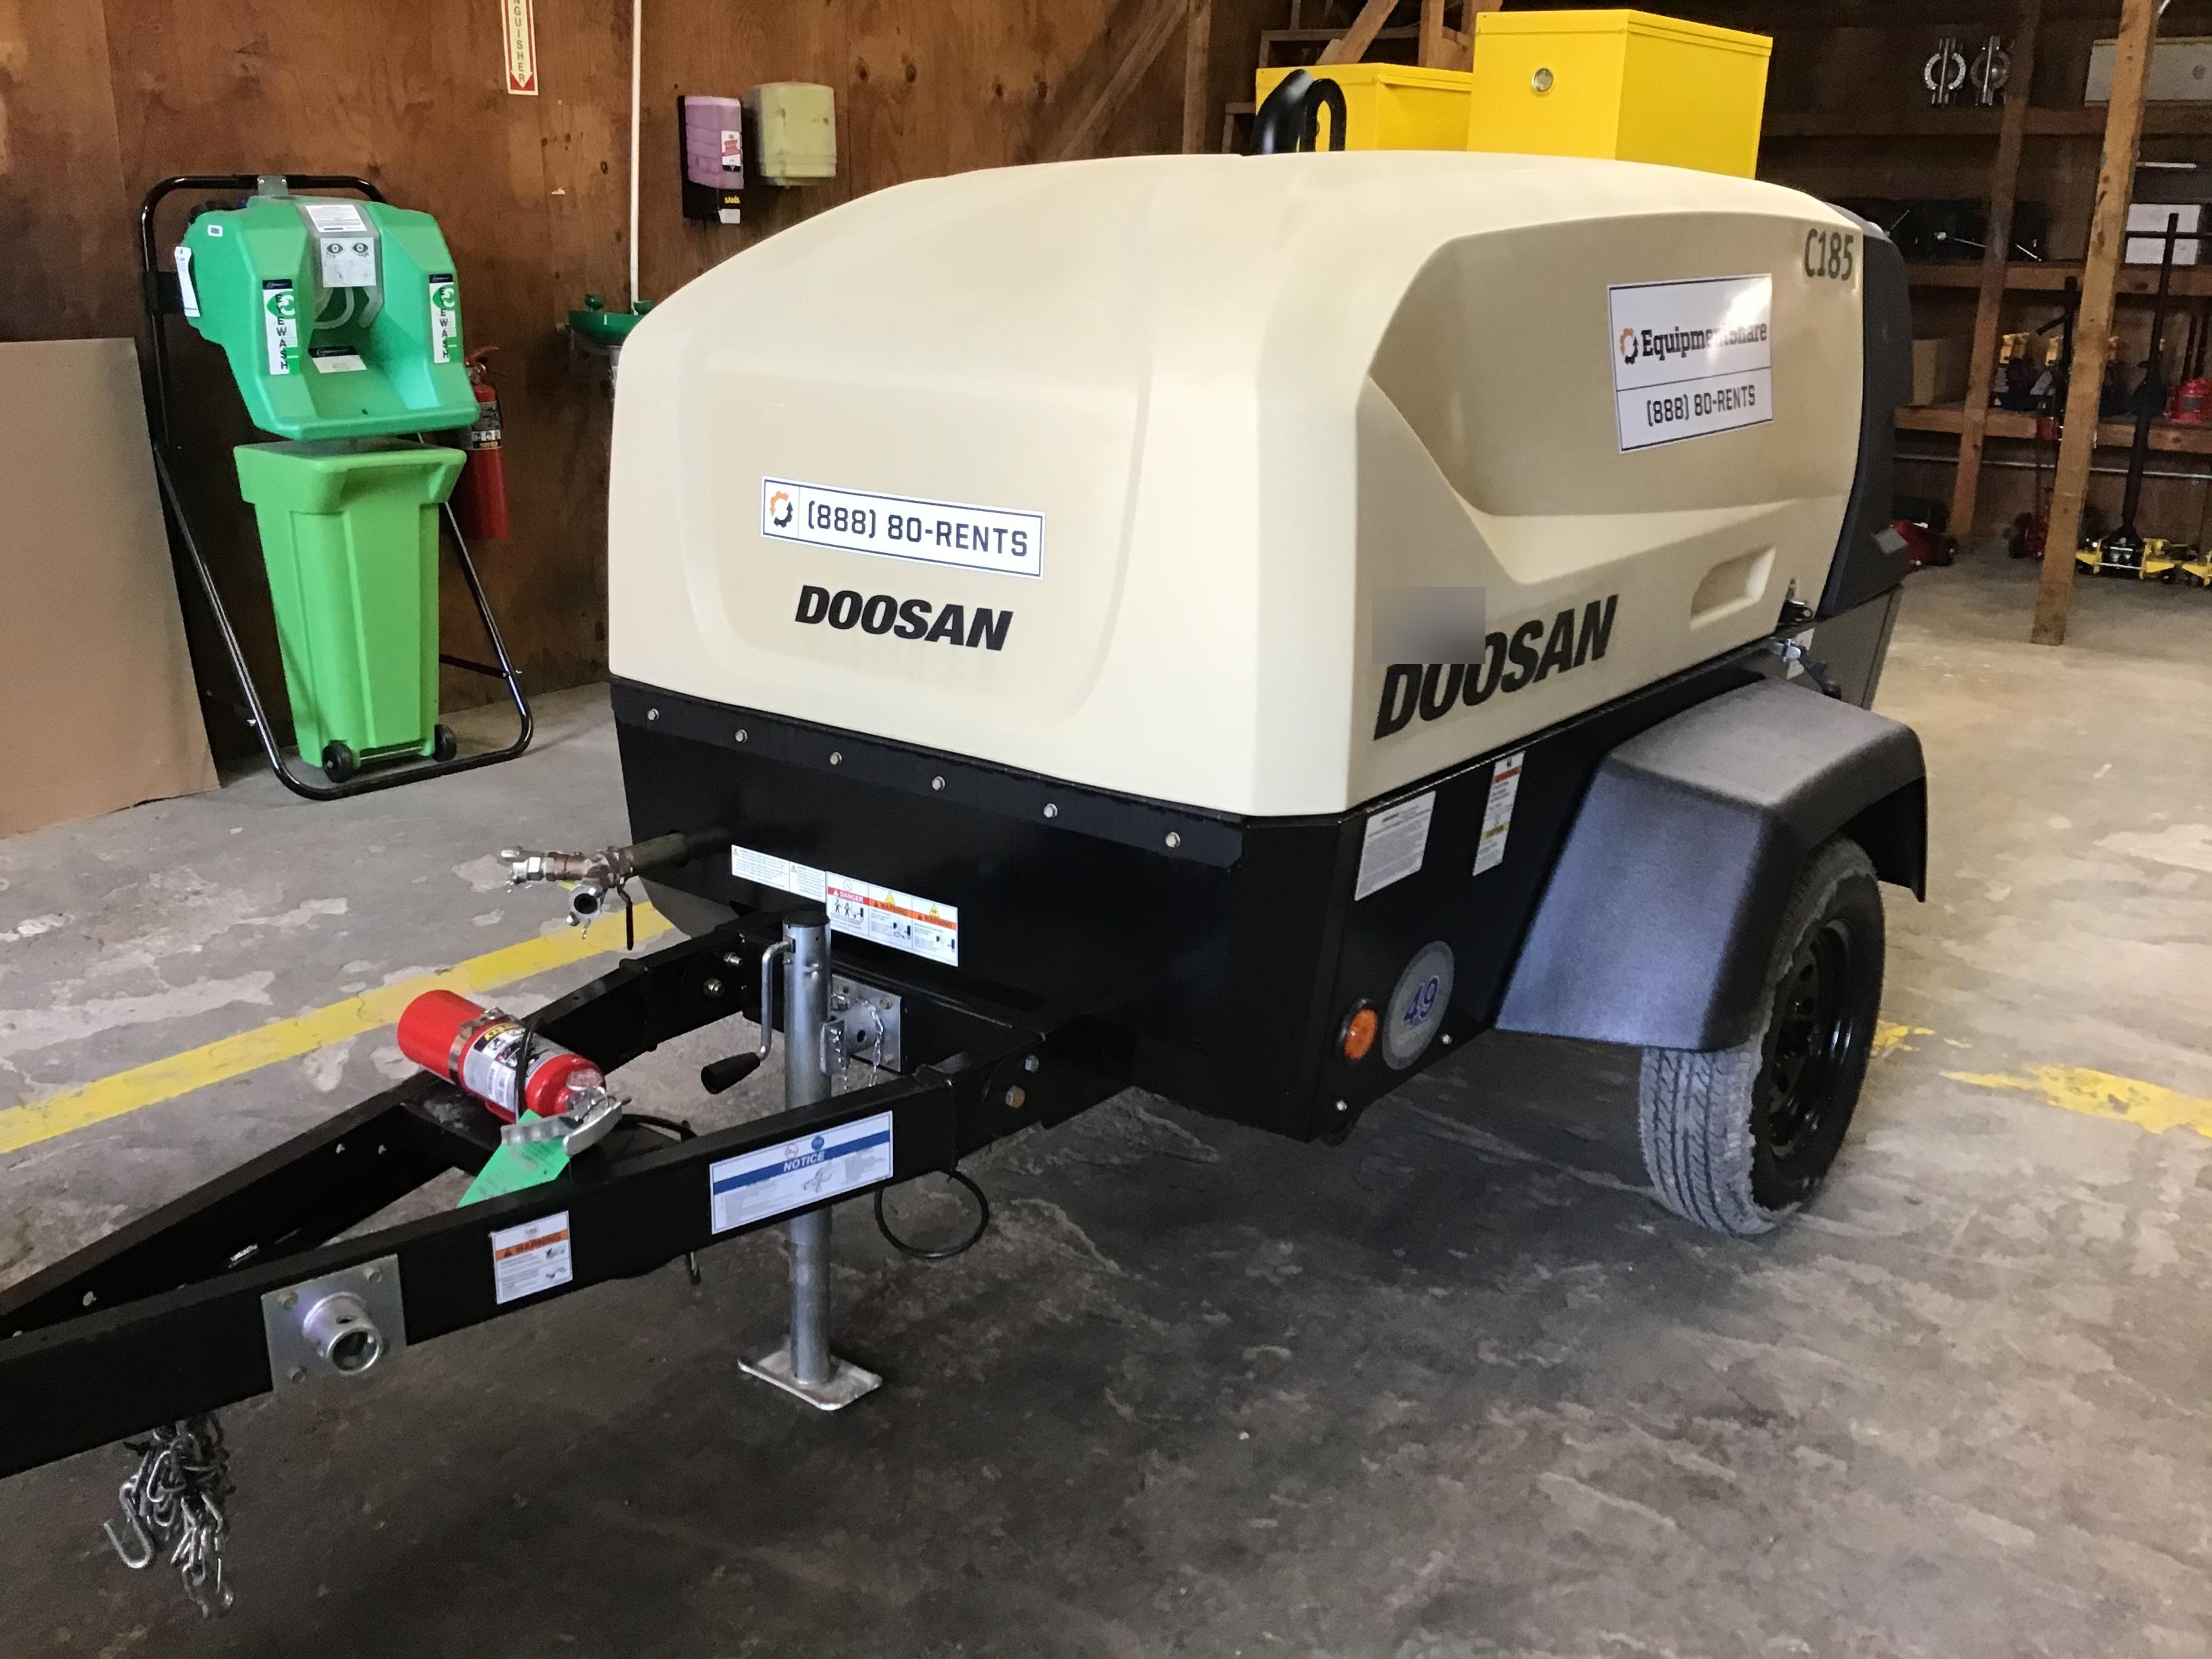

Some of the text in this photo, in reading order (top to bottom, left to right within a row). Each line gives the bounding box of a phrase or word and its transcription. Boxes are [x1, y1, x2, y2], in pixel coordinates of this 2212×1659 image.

[1805, 228, 1854, 281] C185
[274, 293, 288, 369] EYEWASH
[1647, 384, 1756, 426] (888) 80-RENTS
[808, 500, 1028, 557] (888) 80-RENTS
[795, 585, 1014, 651] DOOSAN
[840, 891, 864, 903] DANGER
[1404, 977, 1439, 1025] 49
[783, 1151, 825, 1172] NOTICE
[515, 1233, 561, 1253] WARNING
